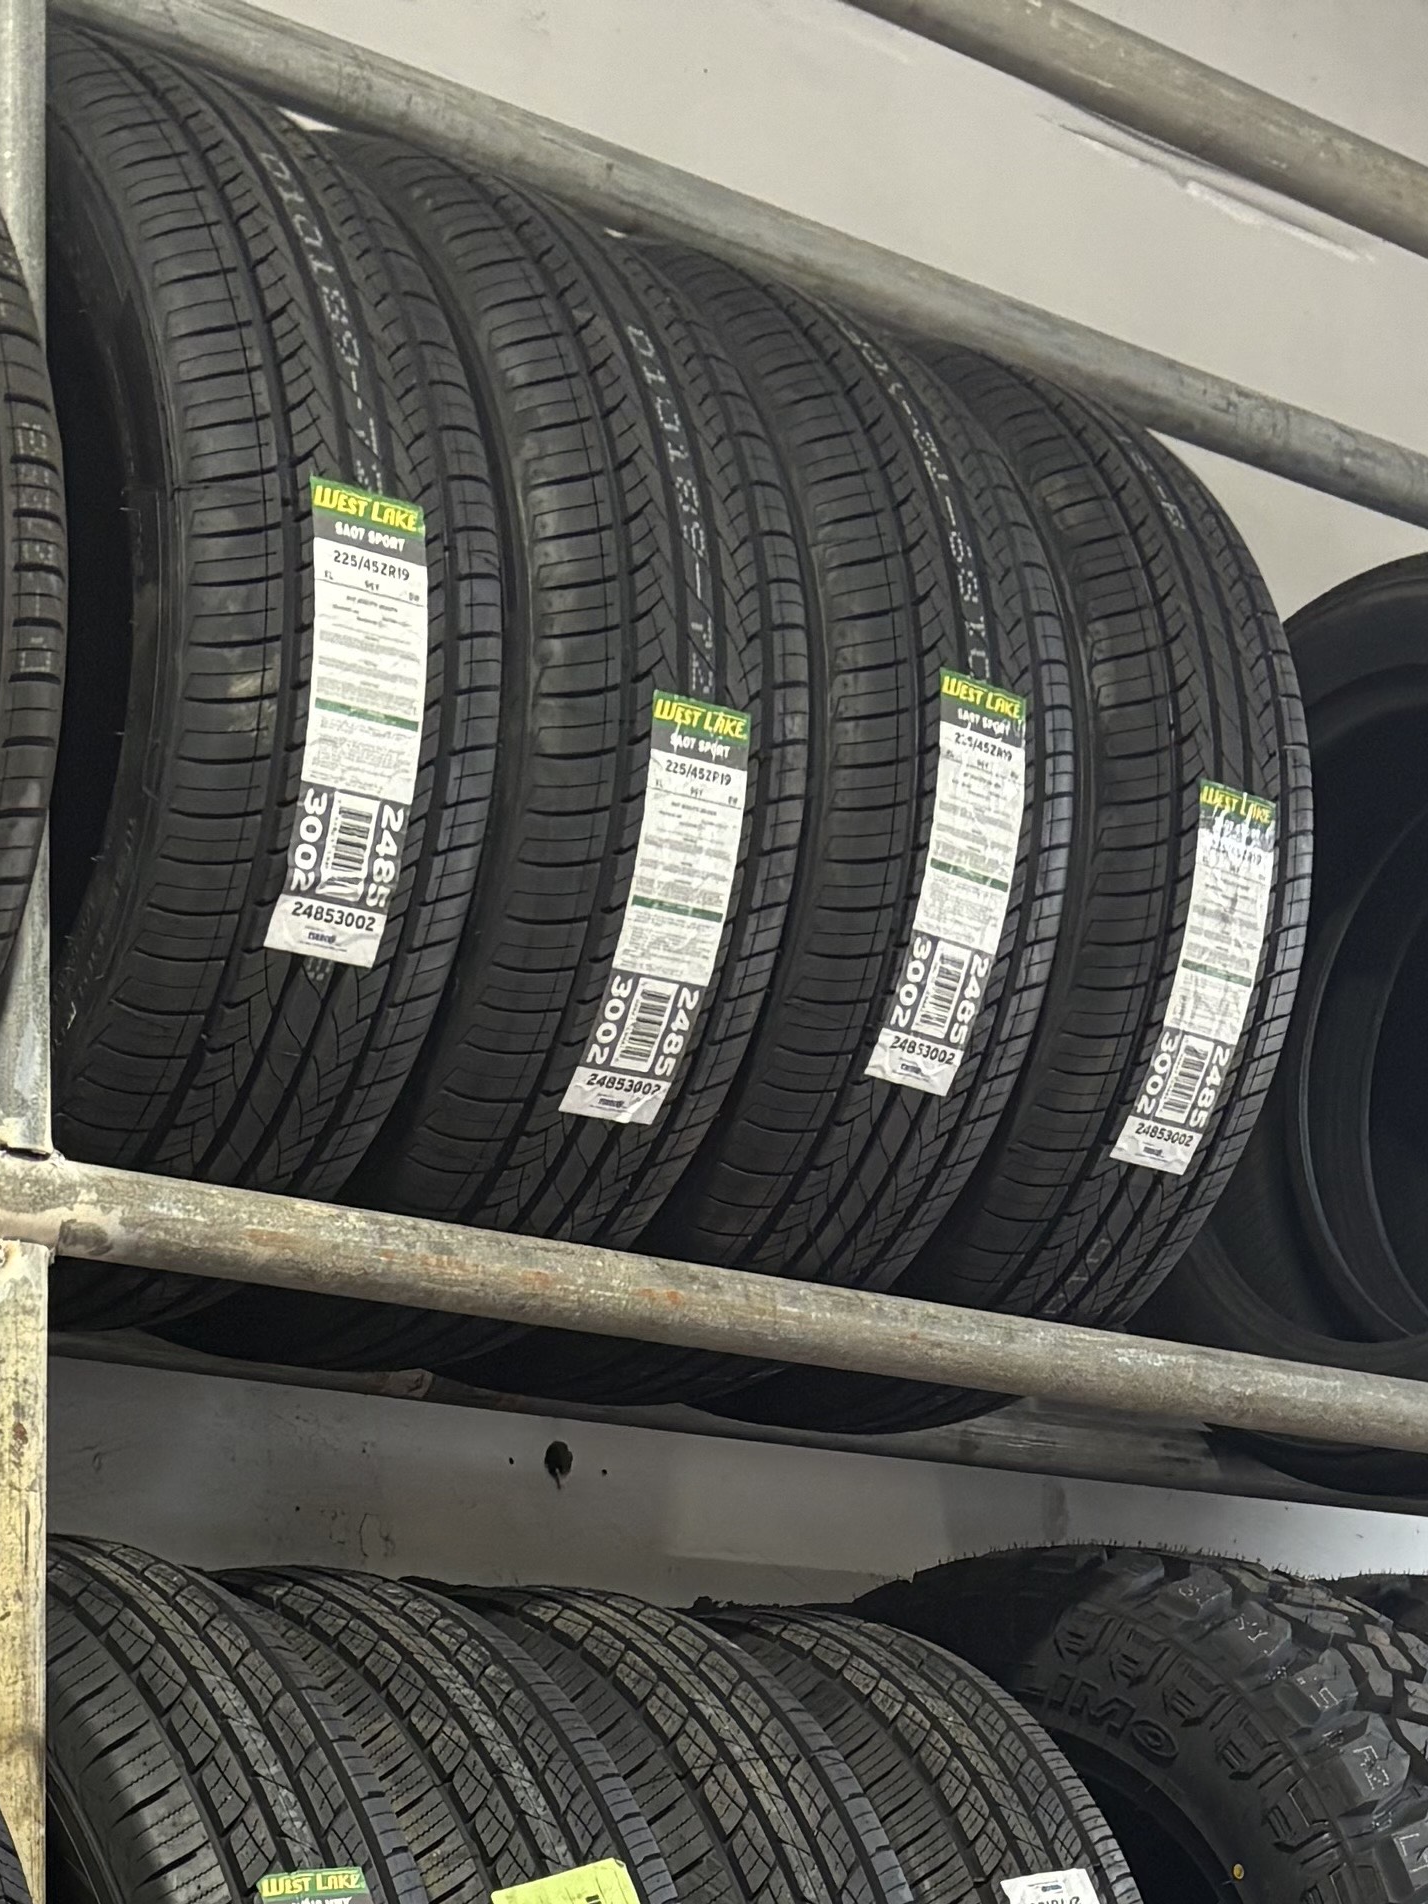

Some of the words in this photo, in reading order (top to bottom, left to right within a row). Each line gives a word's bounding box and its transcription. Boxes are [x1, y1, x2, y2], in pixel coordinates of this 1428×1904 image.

[314, 485, 367, 518] WEST
[371, 502, 418, 532] LAKE
[333, 549, 411, 582] 225/45ZR19
[654, 699, 700, 732] WEST
[704, 716, 747, 739] LAKE
[941, 675, 986, 706] WEST
[988, 690, 1022, 720] LAKE
[1201, 785, 1238, 816] WEST
[290, 788, 328, 893] 3002
[366, 805, 404, 909] 2485
[291, 902, 376, 933] 24853002
[891, 935, 932, 1028] 3002
[950, 957, 989, 1045] 2485
[586, 976, 633, 1065] 3002
[654, 988, 700, 1077] 2485
[890, 1036, 956, 1065] 24853002
[1135, 1031, 1178, 1115] 3002
[586, 1072, 662, 1096] 24853002
[1189, 1044, 1230, 1128] 2485
[1135, 1122, 1194, 1147] 24853002
[261, 1874, 311, 1897] WEST
[315, 1871, 361, 1892] LAKE
